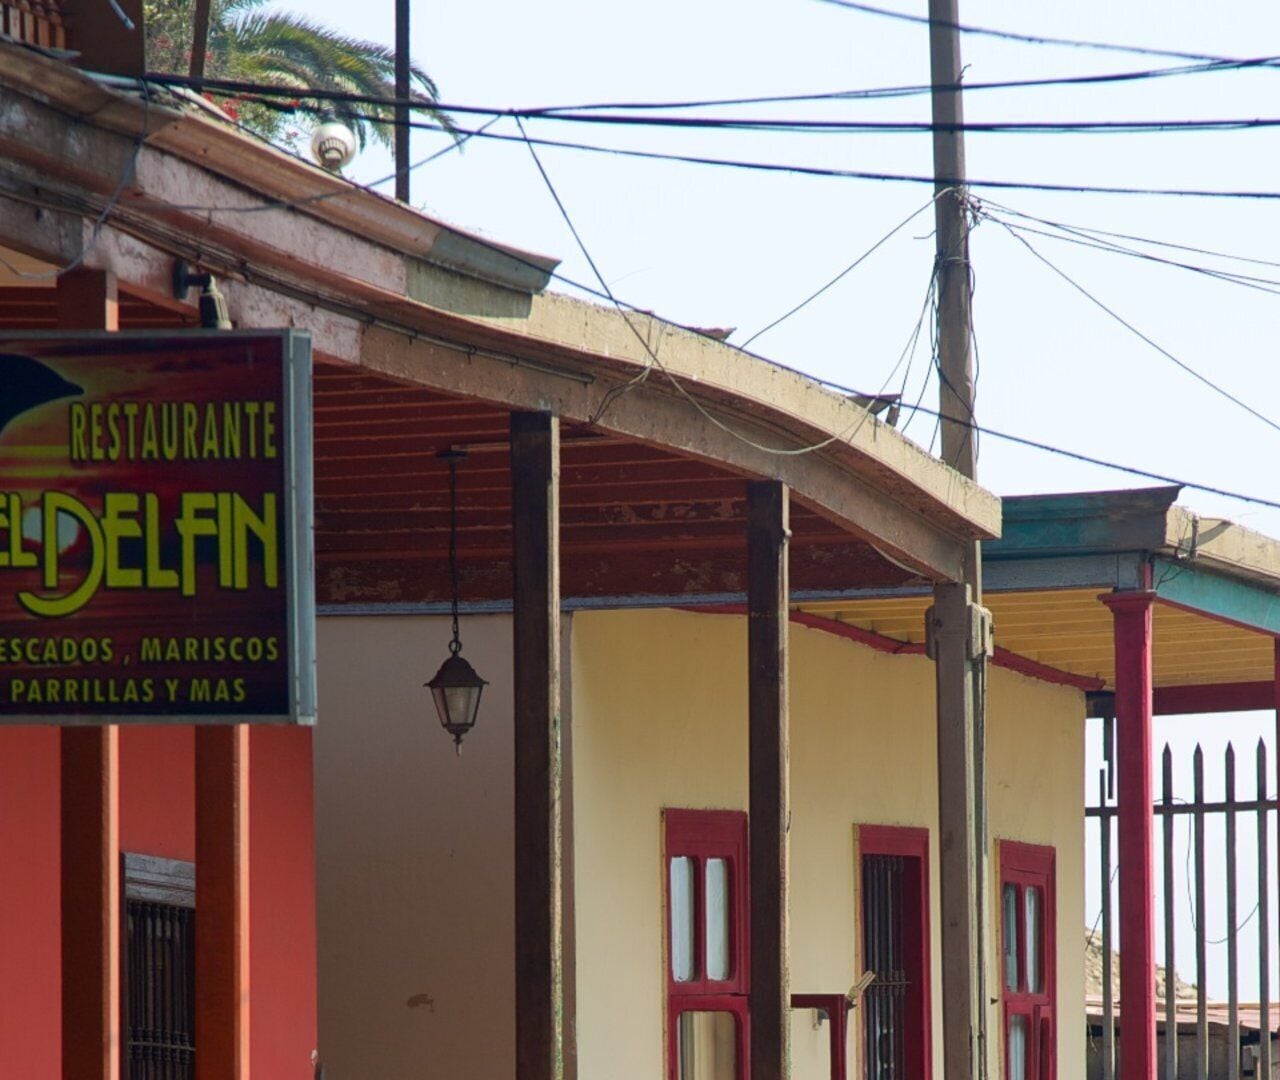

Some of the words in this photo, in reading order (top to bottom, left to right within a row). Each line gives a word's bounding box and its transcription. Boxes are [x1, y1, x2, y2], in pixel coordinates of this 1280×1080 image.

[70, 402, 277, 461] RESTAURANTE
[17, 491, 279, 618] DELFIN
[141, 637, 279, 662] MARISCOS
[11, 678, 154, 703] PARRILLAS
[166, 678, 178, 703] Y
[189, 678, 246, 702] MAS
